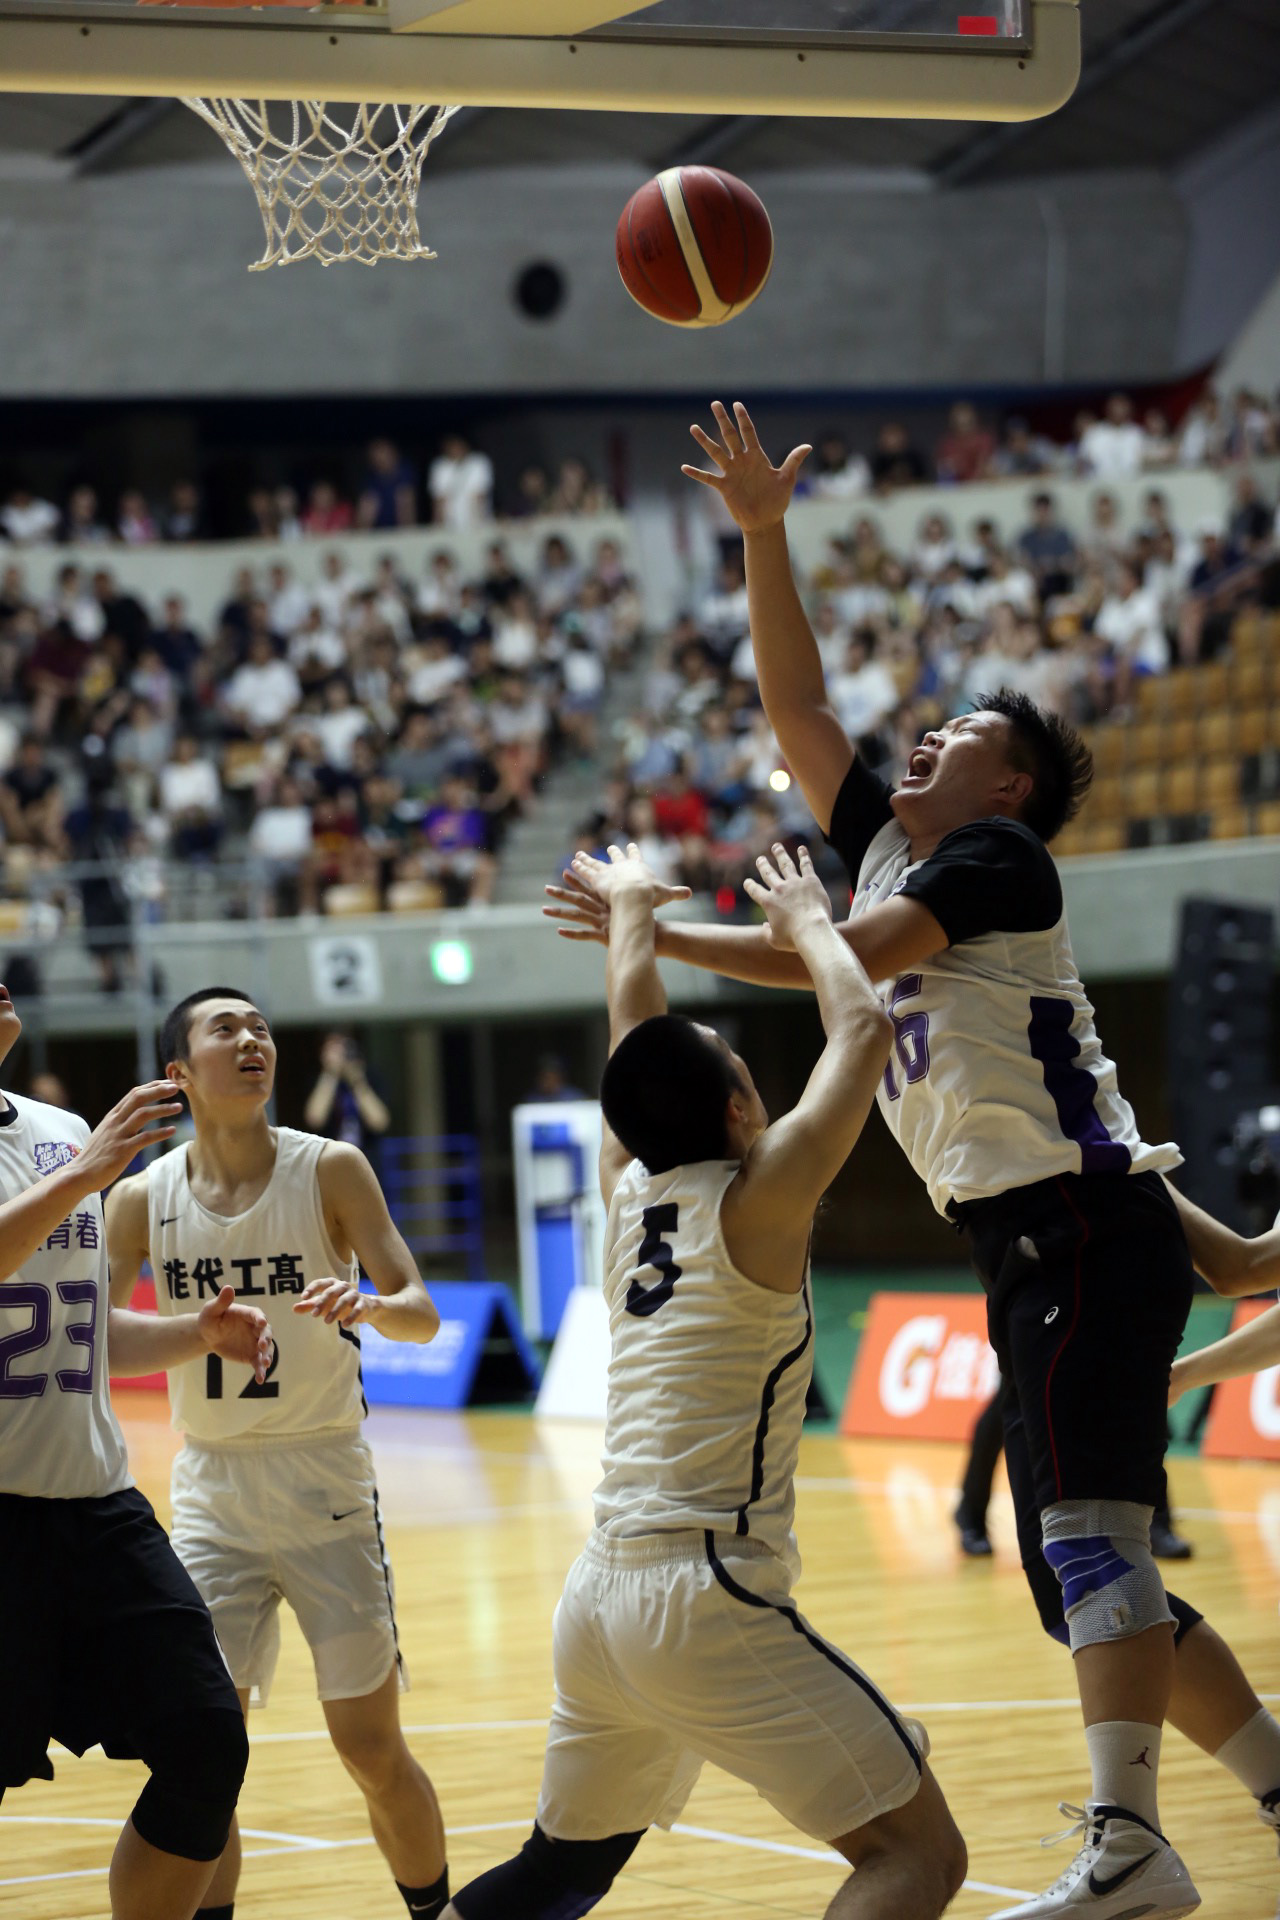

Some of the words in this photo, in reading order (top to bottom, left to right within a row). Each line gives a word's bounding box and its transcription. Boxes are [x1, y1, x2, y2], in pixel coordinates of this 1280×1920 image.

[37, 1211, 99, 1251] 青春
[625, 1202, 682, 1317] 5
[0, 1280, 98, 1399] 23
[206, 1338, 279, 1399] 12
